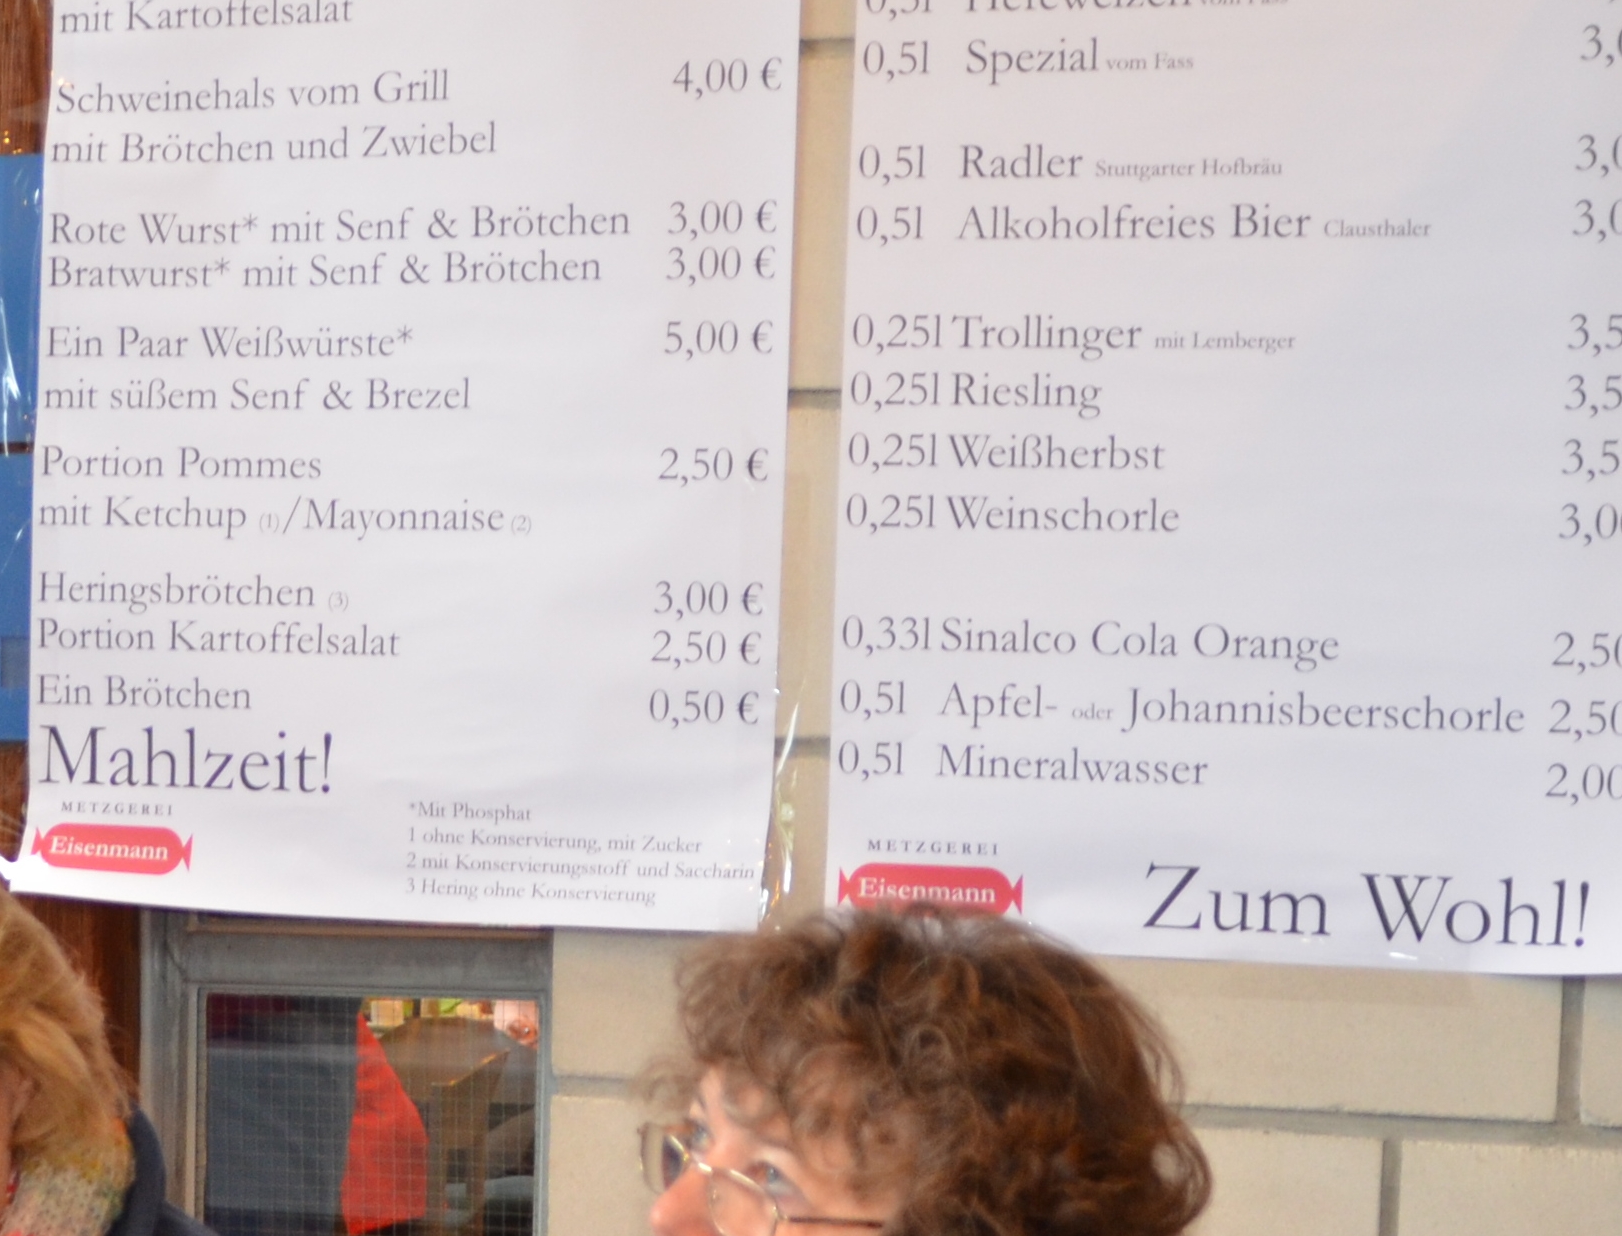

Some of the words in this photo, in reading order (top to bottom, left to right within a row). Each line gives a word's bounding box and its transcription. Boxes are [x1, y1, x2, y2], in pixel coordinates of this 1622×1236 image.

[59, 1, 115, 33] mit
[127, 0, 352, 30] Kartoffelsalat
[673, 61, 748, 99] 4,00
[761, 58, 781, 89] €
[864, 41, 928, 81] 0,5l
[966, 37, 1098, 86] Spezial
[1106, 58, 1147, 70] vom
[1154, 52, 1193, 70] Fass
[57, 77, 274, 113] Schweinehals
[289, 84, 359, 106] vom
[374, 69, 448, 103] Grill
[50, 133, 109, 163] mit
[121, 131, 273, 163] Brötchen
[288, 126, 347, 160] und
[363, 120, 495, 157] Zwiebel
[859, 145, 924, 185] 0,5l
[962, 144, 1083, 178] Radler
[1095, 160, 1195, 182] Stuttgarter
[1202, 157, 1282, 175] Hofbräu
[52, 213, 125, 244] Rote
[270, 211, 326, 243] mit
[337, 207, 414, 241] Senf
[428, 210, 457, 239] &
[473, 203, 629, 237] Brötchen
[668, 201, 743, 240] 3,00
[756, 201, 776, 232] €
[857, 206, 921, 246] 0,5l
[958, 204, 1214, 239] Alkoholfreies
[1233, 204, 1311, 238] Bier
[1324, 218, 1431, 237] Clausthaler
[243, 256, 298, 288] mit
[310, 252, 386, 286] Senf
[400, 255, 429, 284] &
[445, 249, 600, 283] Brötchen
[667, 247, 741, 286] 3,00
[755, 247, 775, 278] €
[49, 327, 102, 357] Ein
[119, 327, 188, 357] Paar
[665, 321, 738, 360] 5,00
[752, 322, 772, 353] €
[853, 314, 941, 354] 0,25l
[952, 315, 1142, 360] Trollinger
[1154, 334, 1184, 349] mit
[1193, 331, 1295, 354] Lemberger
[43, 379, 99, 410] mit
[111, 379, 216, 409] süßem
[231, 378, 309, 410] Senf
[323, 382, 352, 410] &
[367, 377, 469, 409] Brezel
[851, 372, 938, 412] 0,25l
[953, 373, 1102, 419] Riesling
[44, 446, 163, 477] Portion
[180, 447, 321, 479] Pommes
[659, 448, 733, 487] 2,50
[747, 449, 767, 481] €
[849, 433, 936, 473] 0,25l
[949, 434, 1164, 469] Weißherbst
[39, 499, 92, 528] mit
[105, 496, 246, 539] Ketchup
[511, 515, 531, 534] (2)
[847, 494, 934, 534] 0,25l
[947, 496, 1179, 532] Weinschorle
[41, 572, 314, 614] Heringsbrötchen
[328, 591, 348, 611] (3)
[654, 581, 728, 620] 3,00
[741, 583, 763, 615] €
[41, 618, 154, 650] Portion
[170, 620, 399, 656] Kartoffelsalat
[651, 630, 726, 669] 2,50
[740, 633, 761, 664] €
[843, 616, 929, 656] 0,33l
[941, 618, 1076, 654] Sinalco
[1092, 622, 1177, 656] Cola
[1194, 625, 1338, 671] Orange
[40, 674, 91, 705] Ein
[106, 676, 250, 709] Brötchen
[650, 690, 724, 728] 0,50
[737, 692, 758, 724] €
[841, 681, 904, 720] 0,5l
[941, 682, 1057, 729] Apfel-
[1072, 703, 1113, 720] oder
[1121, 688, 1524, 733] Johannisbeerschorle
[42, 726, 332, 793] Mahlzeit!
[838, 742, 902, 781] 0,5l
[938, 744, 1208, 784] Mineralwasser
[62, 802, 171, 816] METZGEREI
[453, 802, 530, 825] Phosphat
[48, 834, 169, 862] Eisenmann
[408, 827, 415, 842] 1
[423, 827, 464, 844] ohne
[471, 829, 601, 853] Konservierung,
[608, 837, 635, 850] mit
[642, 836, 701, 853] Zucker
[868, 839, 997, 855] METZGEREI
[406, 852, 416, 869] 2
[422, 856, 449, 869] mit
[456, 854, 627, 879] Konservierungsstoff
[637, 862, 669, 877] und
[675, 863, 754, 879] Saccharin
[406, 877, 415, 892] 3
[422, 878, 477, 899] Hering
[484, 881, 524, 897] ohne
[532, 883, 655, 906] Konservierung
[857, 876, 996, 905] Eisenmann
[1144, 862, 1329, 935] Zum
[1362, 874, 1589, 947] Wohl!
